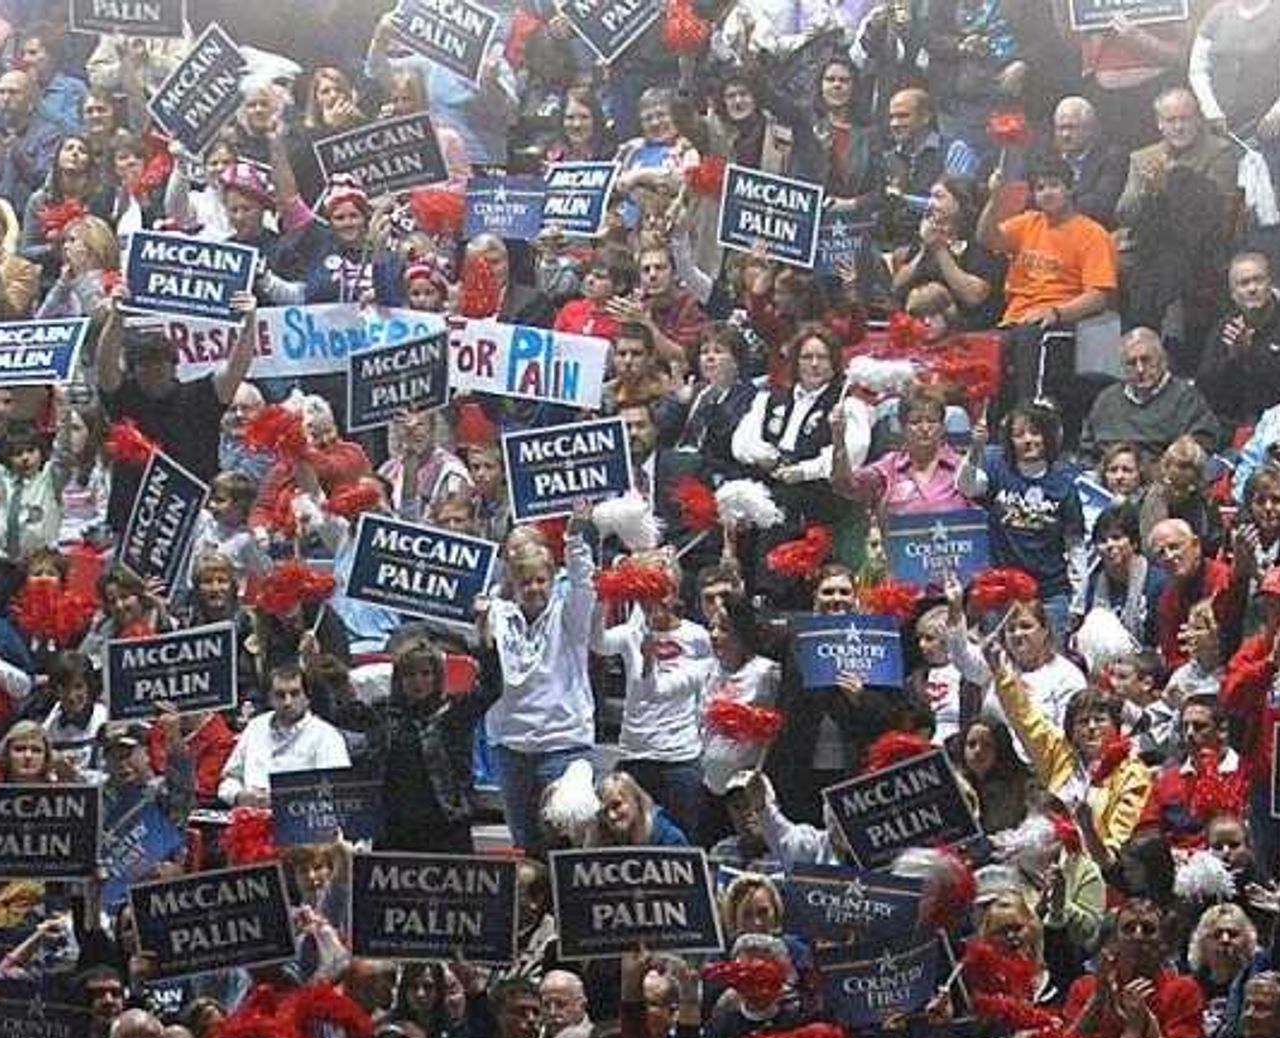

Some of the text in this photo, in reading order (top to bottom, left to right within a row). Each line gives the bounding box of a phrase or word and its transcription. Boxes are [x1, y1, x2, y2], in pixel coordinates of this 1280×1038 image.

[408, 16, 468, 60] PALIN
[160, 37, 223, 117] McCAIN
[185, 67, 240, 130] PALIN
[331, 120, 425, 165] McCAIN
[354, 152, 423, 187] PALIN
[547, 170, 606, 187] McCAIN
[542, 196, 590, 215] PALIN
[734, 175, 812, 212] McCAIN
[737, 210, 798, 243] PALIN
[139, 239, 243, 274] McCAIN
[147, 272, 224, 303] PALIN
[360, 341, 442, 378] McCAIN
[370, 375, 433, 407] PALIN
[518, 425, 616, 464] McCAIN
[534, 465, 609, 495] PALIN
[124, 465, 168, 566] McCAIN
[149, 495, 187, 579] PALIN
[370, 526, 482, 569] McCAIN
[906, 539, 973, 558] COUNTRY
[376, 563, 461, 600] PALIN
[119, 639, 221, 669] McCAIN
[816, 644, 887, 660] COUNTRY
[834, 656, 873, 671] FIRST
[133, 672, 211, 700] PALIN
[841, 765, 942, 818] McCAIN
[867, 806, 943, 847] PALIN
[369, 862, 501, 894] McCAIN
[571, 859, 696, 887] McCAIN
[149, 875, 270, 919] McCAIN
[807, 889, 897, 919] COUNTRY
[383, 906, 484, 937] PALIN
[590, 901, 688, 930] PALIN
[169, 918, 262, 954] PALIN
[841, 962, 924, 996] COUNTRY
